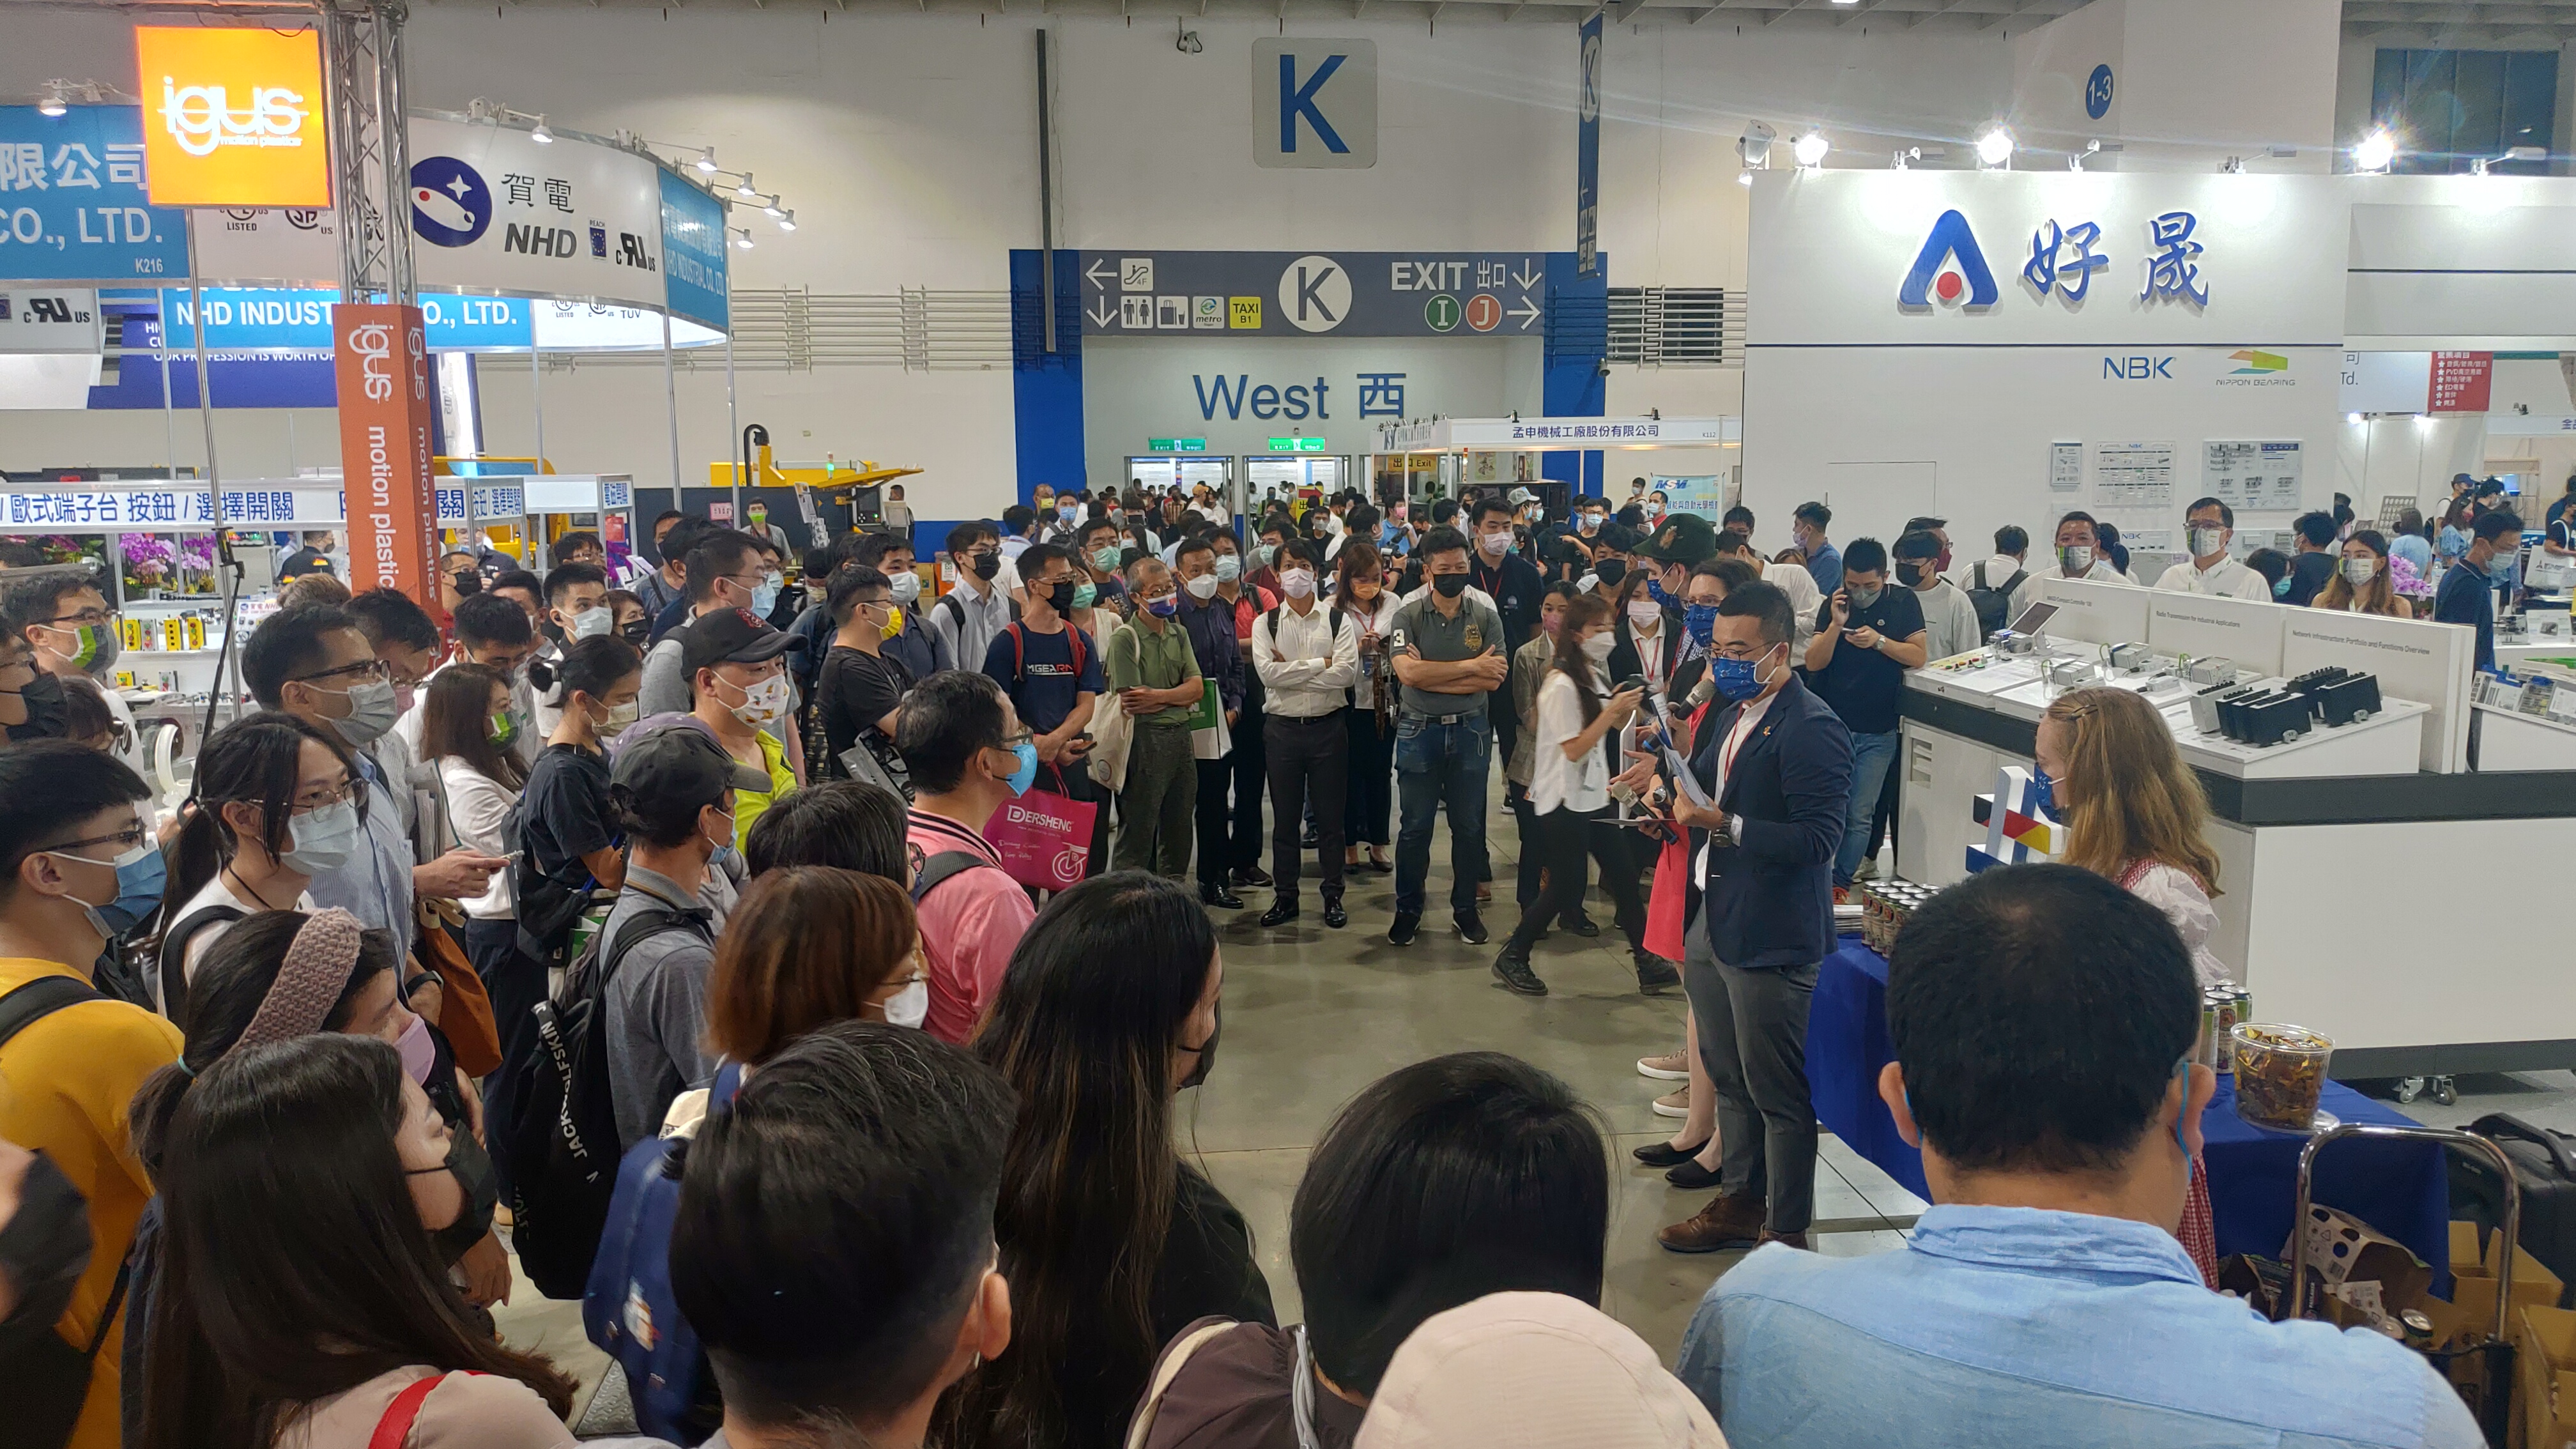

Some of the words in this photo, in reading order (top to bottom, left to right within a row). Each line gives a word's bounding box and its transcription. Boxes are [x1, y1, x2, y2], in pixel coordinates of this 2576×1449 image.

[1280, 54, 1351, 153] K
[2089, 75, 2112, 107] 1-3
[160, 75, 307, 156] igus
[501, 172, 574, 213] 賀電
[79, 208, 162, 243] LTD.
[227, 222, 257, 231] LISTED
[505, 223, 577, 258] NHD
[135, 257, 164, 273] K216
[1392, 262, 1469, 291] EXIT
[1477, 261, 1506, 289] 出口
[2023, 211, 2208, 307] 好晟
[1233, 303, 1259, 314] TAXI
[1297, 266, 1335, 321] K
[240, 301, 332, 325] INDUST
[463, 301, 517, 326] LTD.
[1477, 302, 1491, 325] J
[349, 320, 393, 404] igus
[408, 326, 426, 401] igus
[2103, 356, 2175, 380] NBK
[1193, 374, 1329, 420] West
[1357, 373, 1406, 419] 西
[2216, 378, 2250, 387] NIPPON
[2253, 378, 2296, 387] BEARING
[1512, 425, 1659, 438] 孟申機械工廠股份有限公司
[369, 426, 392, 507] motion
[418, 427, 429, 505] motion
[11, 493, 118, 523] 歐式端子台
[128, 492, 176, 522] 按鈕
[196, 491, 295, 522] 選擇開關
[370, 514, 399, 589] plastic
[422, 513, 436, 599] plastics
[1393, 629, 1405, 647] 3
[1007, 805, 1072, 832] DERSHENG
